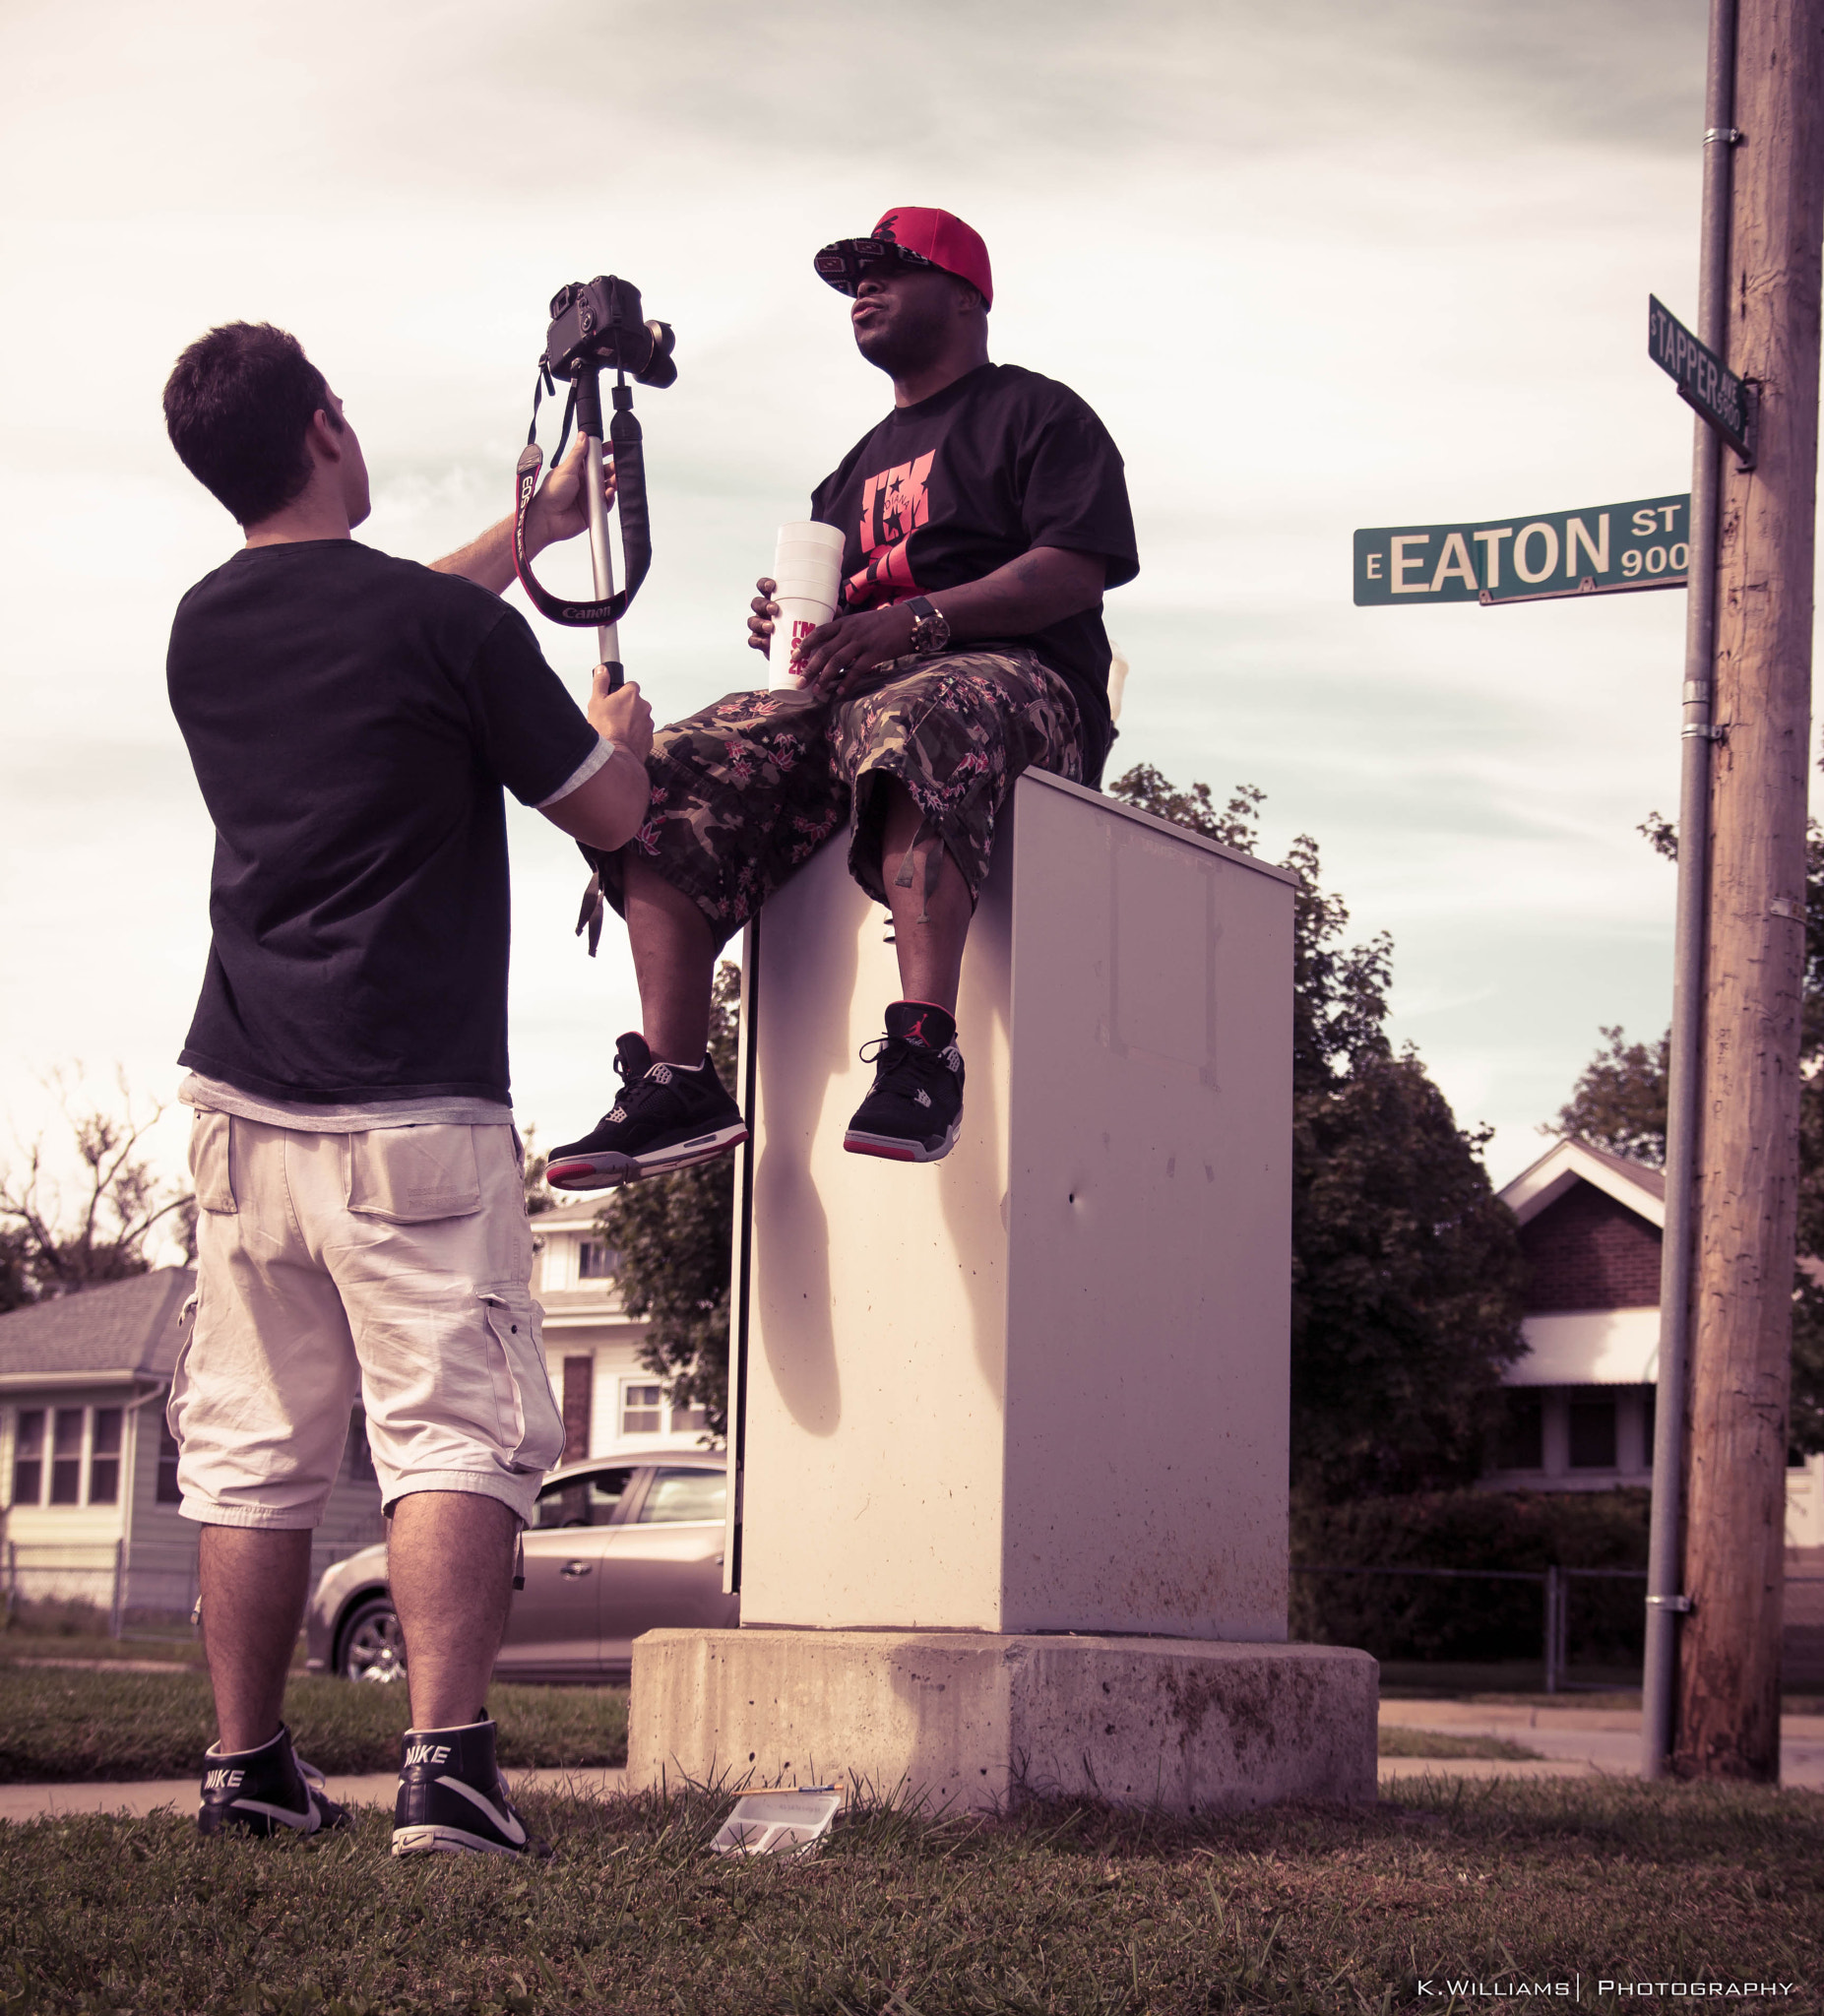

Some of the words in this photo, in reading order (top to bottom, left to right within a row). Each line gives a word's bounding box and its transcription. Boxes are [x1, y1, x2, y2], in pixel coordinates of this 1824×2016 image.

[1651, 312, 1658, 337] S
[1657, 309, 1719, 410] TAPPER
[1721, 372, 1738, 405] AVE
[520, 475, 534, 509] EOS
[1366, 553, 1383, 580] E
[1390, 513, 1610, 594] EATON
[1631, 504, 1682, 536] ST
[1621, 542, 1689, 577] 900
[562, 605, 610, 619] Canon
[404, 1745, 452, 1768] NIKE
[204, 1769, 245, 1789] NIKE
